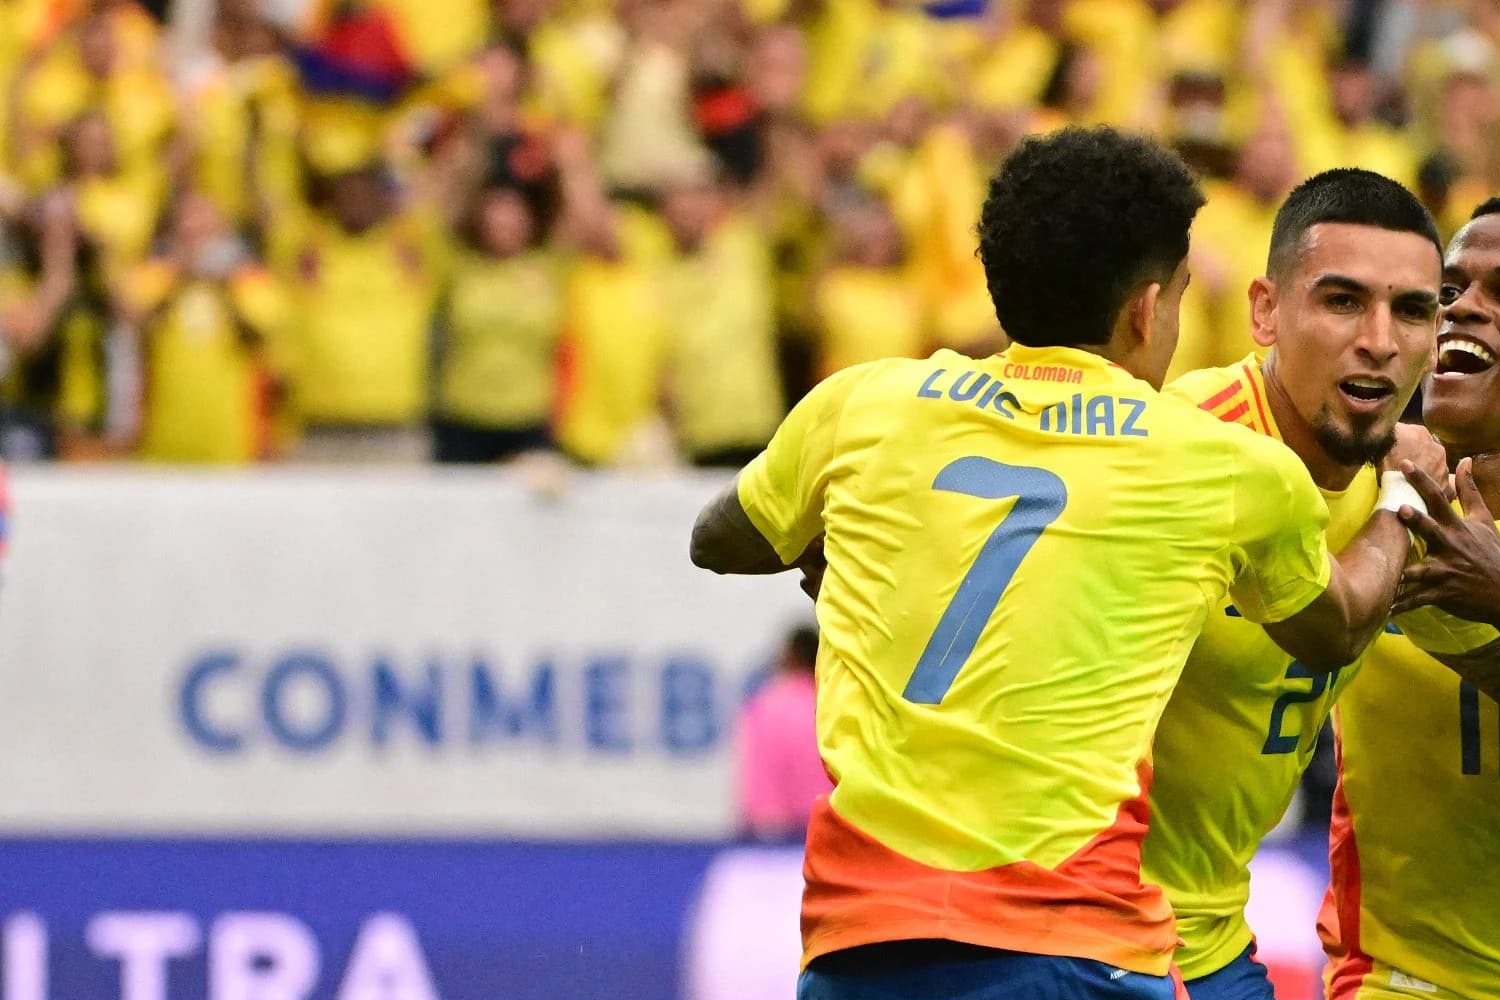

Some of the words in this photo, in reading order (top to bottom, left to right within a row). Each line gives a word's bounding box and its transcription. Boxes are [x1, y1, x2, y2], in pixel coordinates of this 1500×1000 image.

[1003, 362, 1083, 385] COLOMBIA
[901, 455, 1068, 706] 7
[175, 646, 775, 757] CONMEB
[1261, 659, 1341, 754] 2
